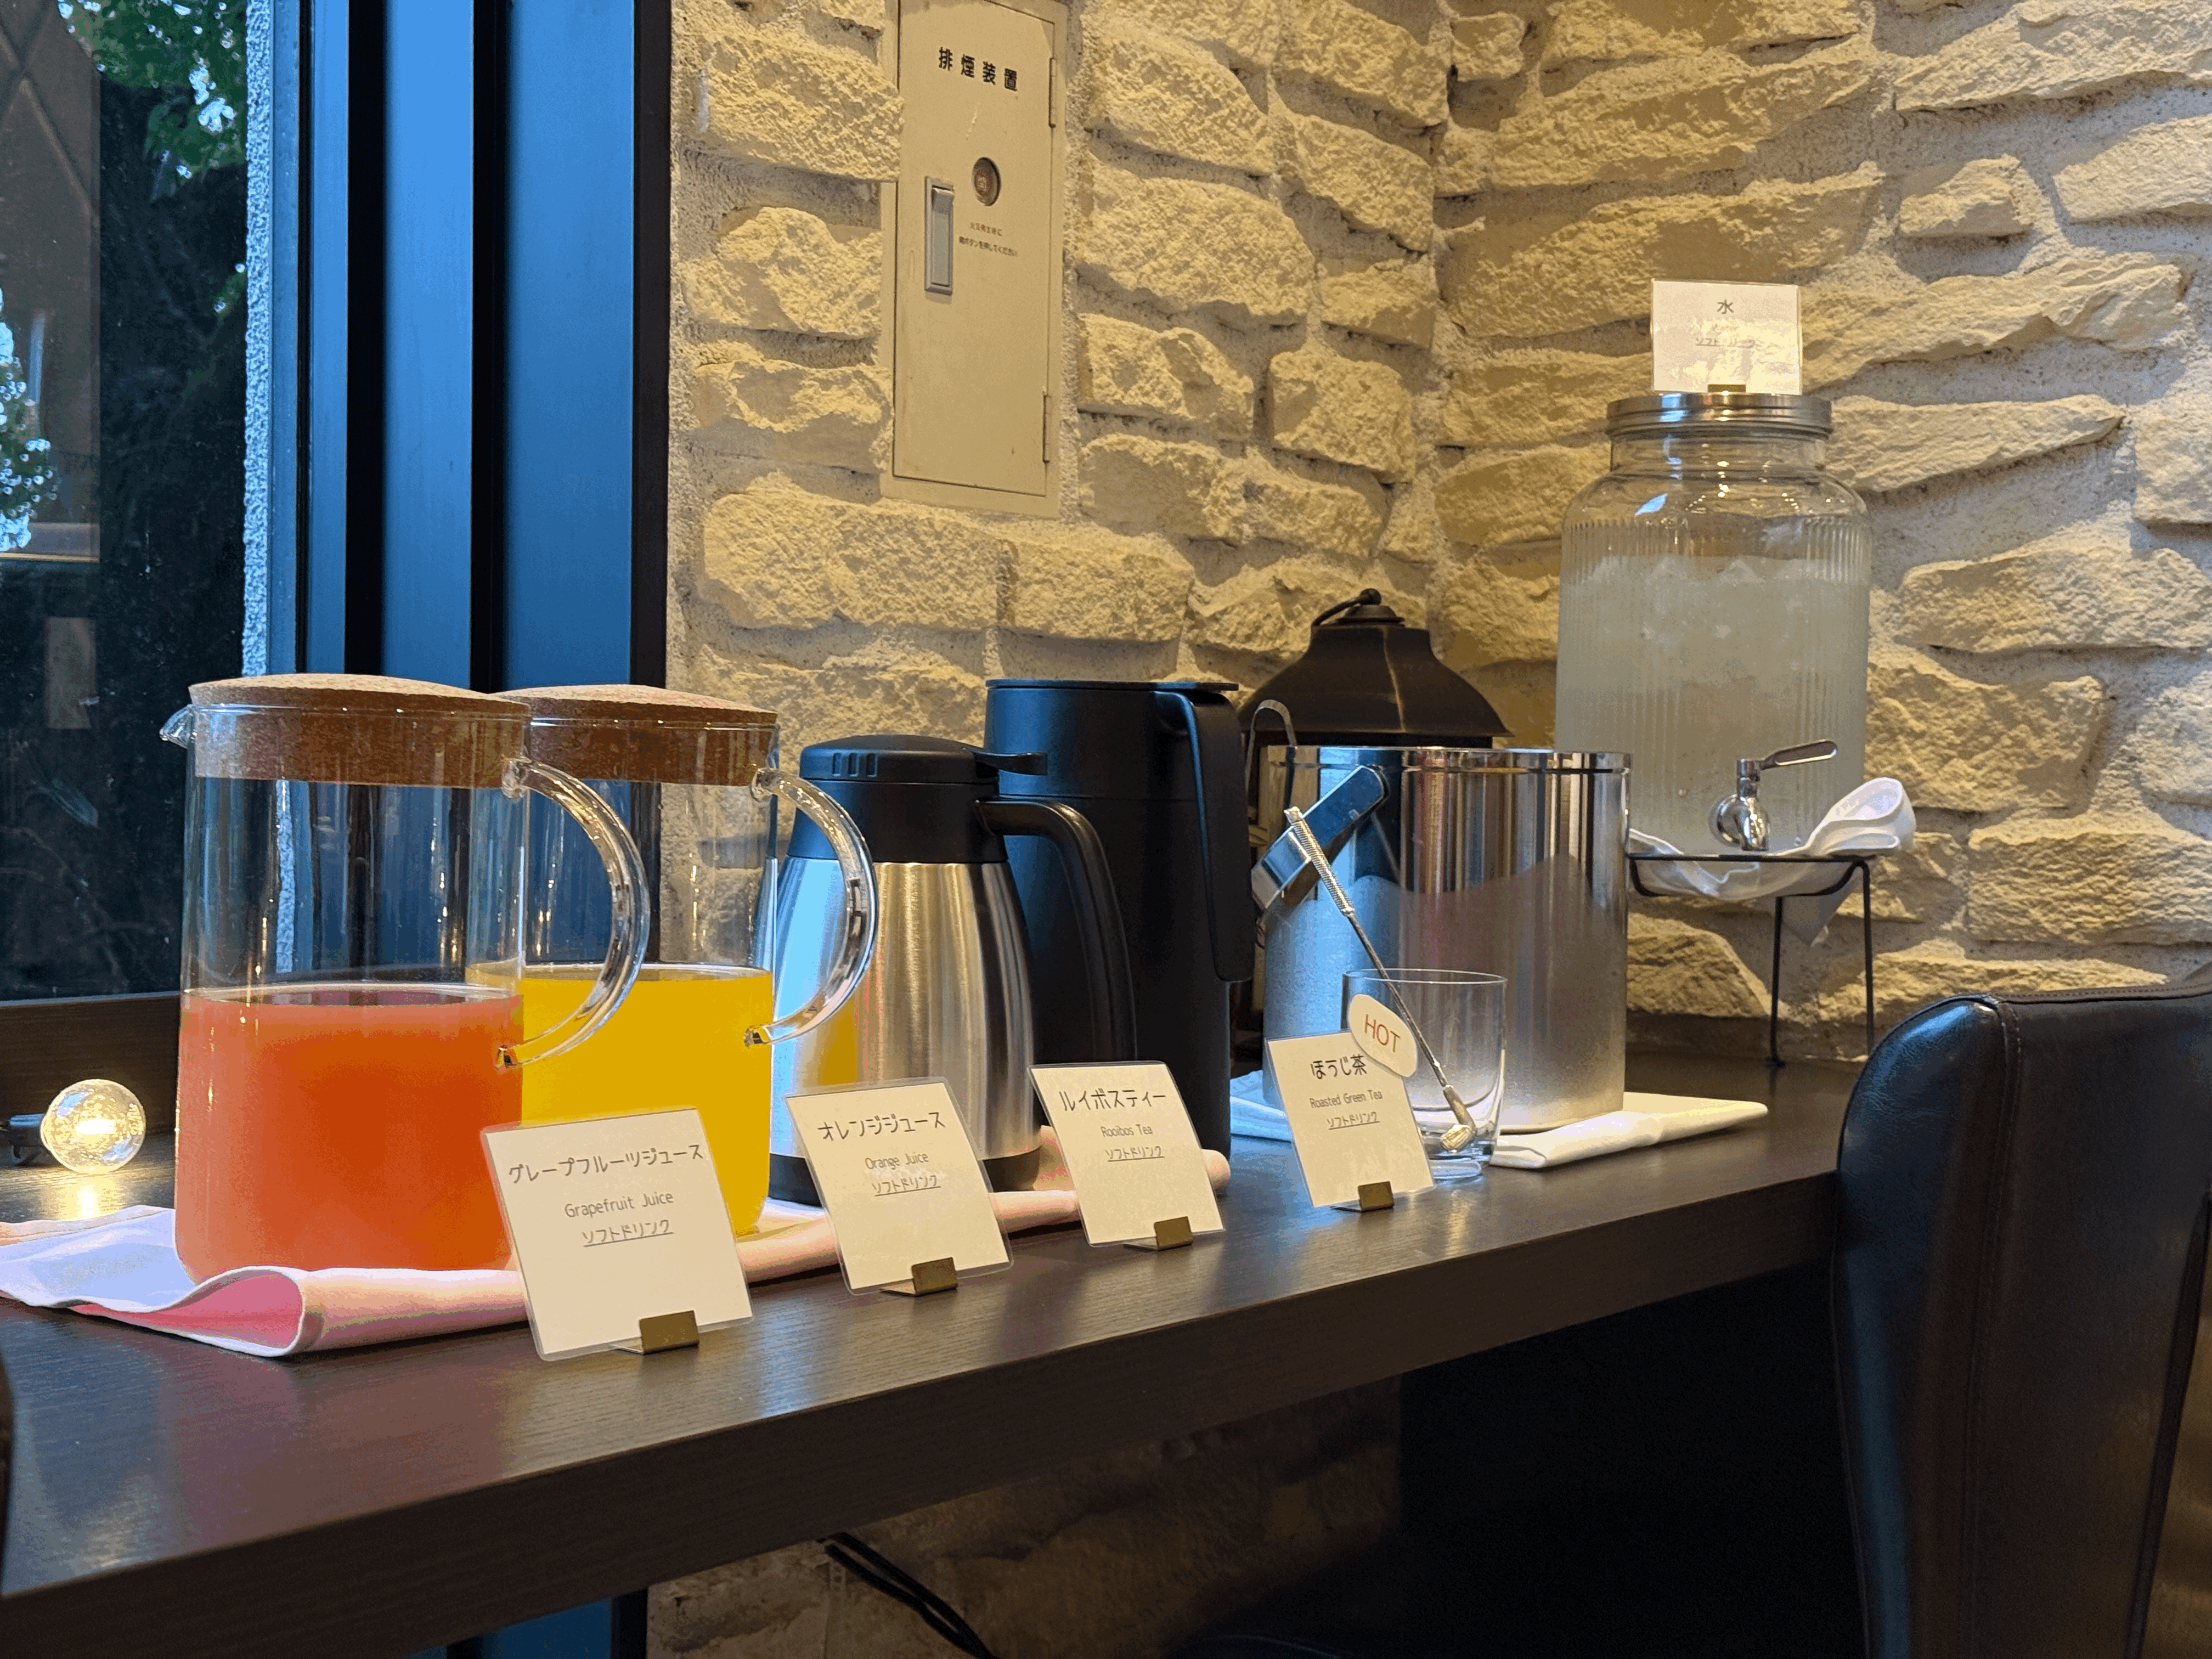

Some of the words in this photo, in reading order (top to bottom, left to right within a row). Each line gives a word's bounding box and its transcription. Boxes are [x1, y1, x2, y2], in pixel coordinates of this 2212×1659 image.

[938, 47, 1018, 91] 排煙装置
[1716, 299, 1734, 314] 水
[1364, 1014, 1401, 1053] HOT
[1310, 1054, 1367, 1079] ほうじ茶
[1059, 1088, 1166, 1111] ルイボスティー
[1310, 1093, 1341, 1108] Roasted
[1343, 1092, 1367, 1104] Green
[1368, 1090, 1384, 1101] Tea
[817, 1112, 945, 1141] オレンジジュース
[1101, 1126, 1135, 1137] Rooibos
[1136, 1124, 1153, 1135] Tea
[1327, 1111, 1379, 1129] ソフトドリンク
[509, 1144, 703, 1184] グレープフルーツジュース
[865, 1156, 900, 1170] Orange
[906, 1152, 929, 1165] Juice
[1105, 1146, 1164, 1161] ソフトドリンク
[871, 1175, 939, 1195] ソフトドリンク
[565, 1197, 635, 1218] Grapefruit
[642, 1191, 674, 1207] Juice
[583, 1220, 672, 1245] ソフトドリンク
